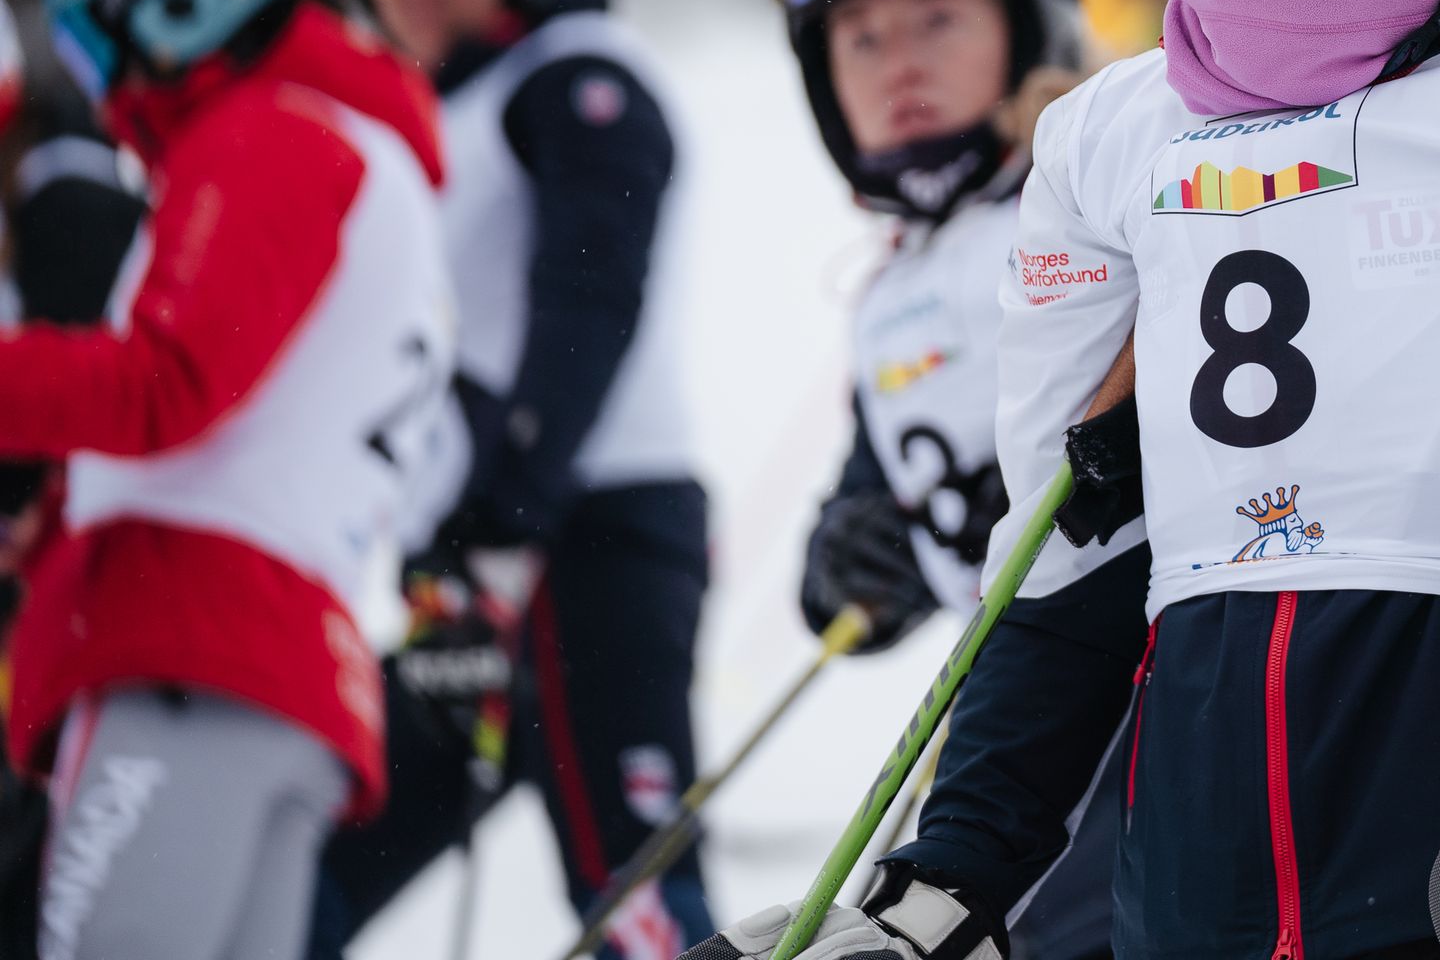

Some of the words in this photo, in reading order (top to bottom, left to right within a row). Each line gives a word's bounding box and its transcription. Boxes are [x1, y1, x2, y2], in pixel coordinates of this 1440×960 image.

[1018, 248, 1069, 272] Norges
[1022, 264, 1108, 288] Skiforbund
[1190, 249, 1317, 448] 8
